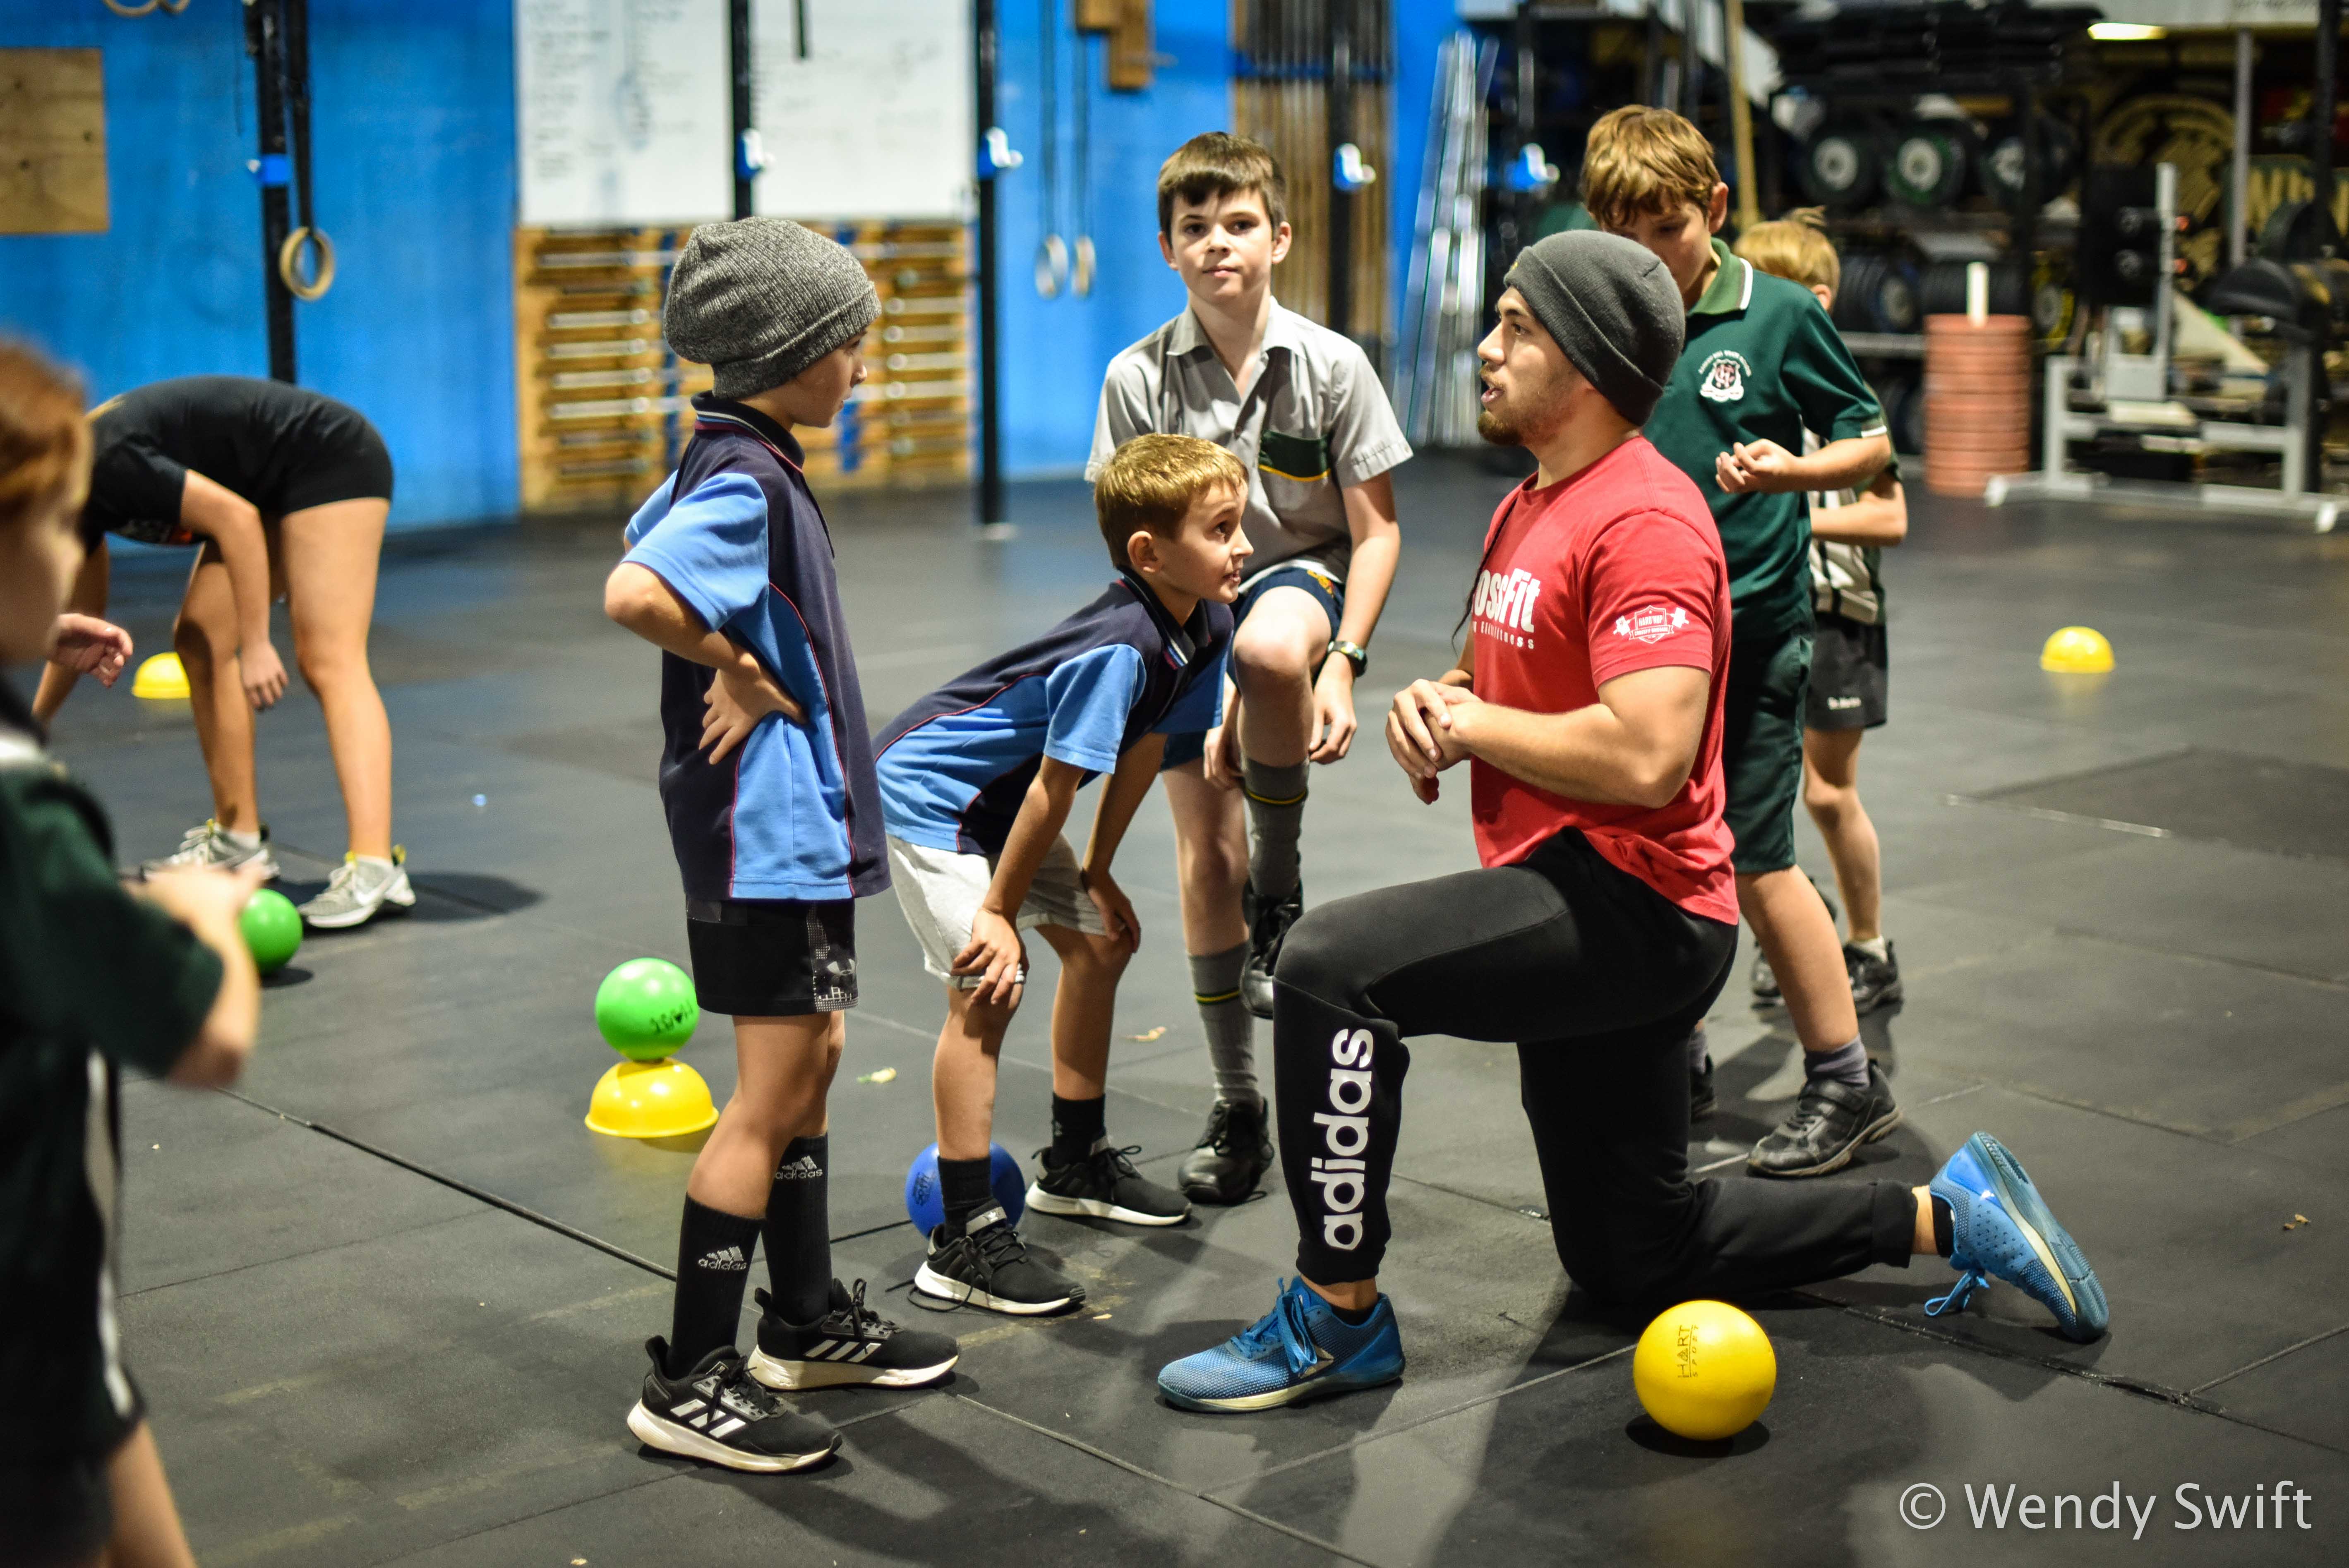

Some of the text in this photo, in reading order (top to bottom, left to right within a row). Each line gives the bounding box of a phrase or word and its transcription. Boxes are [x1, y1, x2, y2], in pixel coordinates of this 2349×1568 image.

[1473, 568, 1540, 633] ossFit
[1310, 1029, 1373, 1250] adidas
[775, 1168, 823, 1180] adidas
[698, 1258, 747, 1270] adidas
[1677, 1324, 1690, 1378] HART
